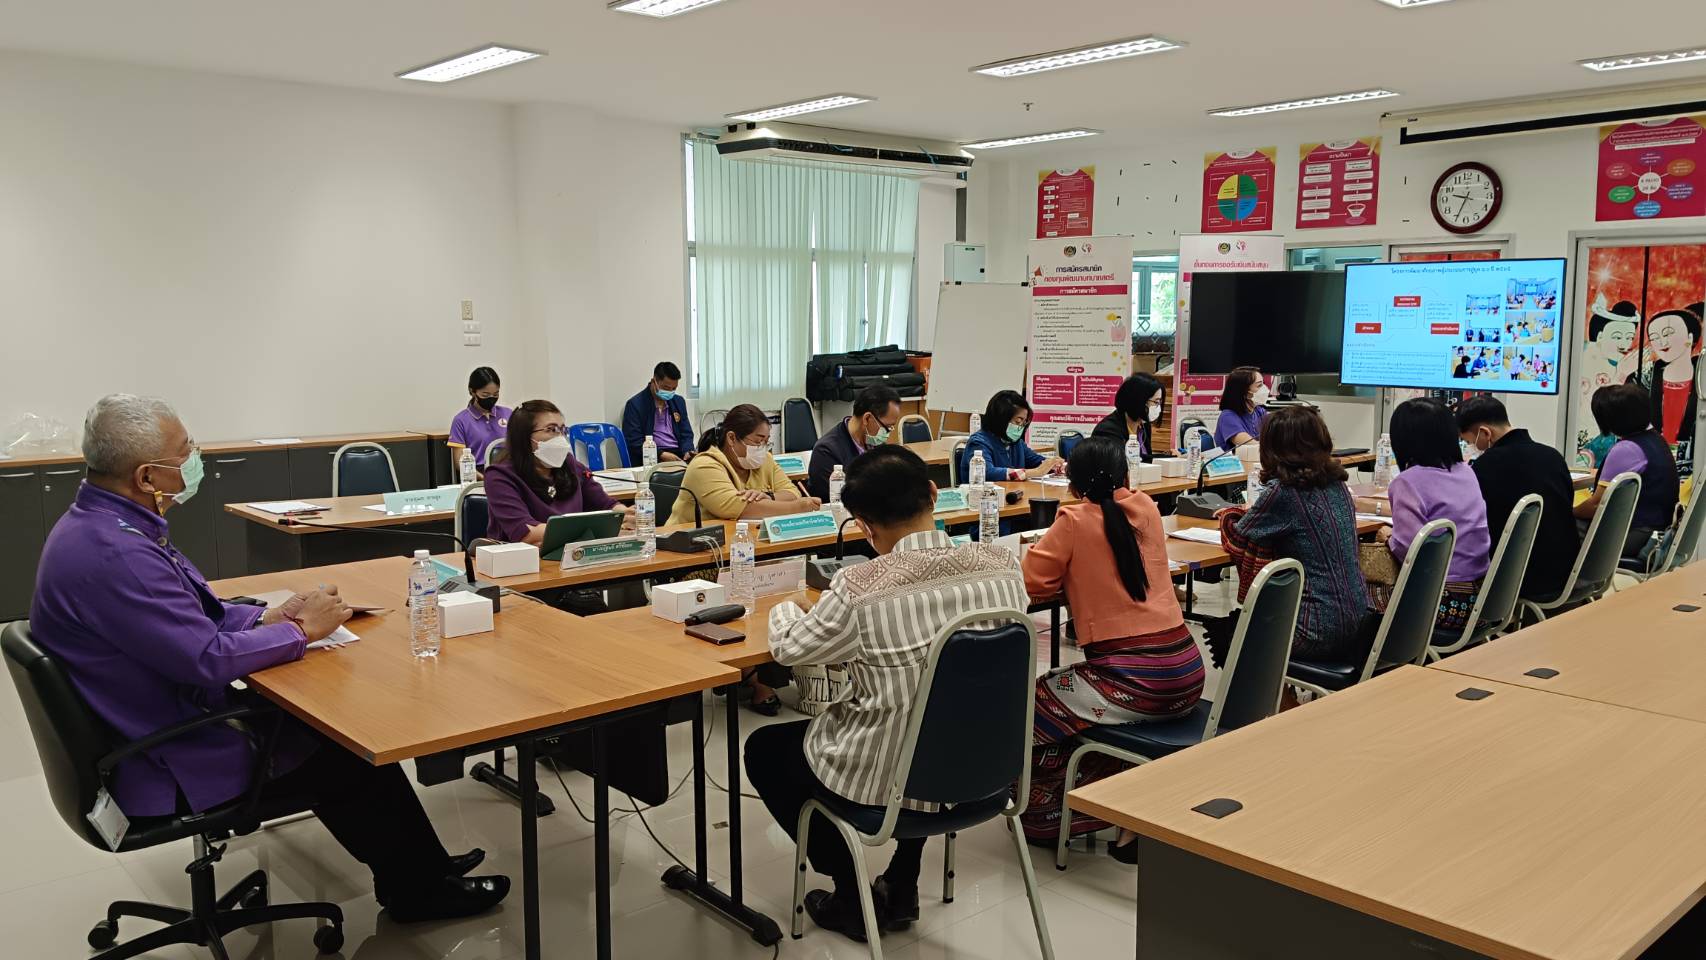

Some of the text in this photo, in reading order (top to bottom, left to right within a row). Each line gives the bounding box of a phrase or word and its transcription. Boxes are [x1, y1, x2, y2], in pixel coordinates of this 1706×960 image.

[1055, 264, 1103, 273] การสมัครสมาชิก
[1043, 273, 1115, 284] กองทุนพัฒนาบทบาทสตรี
